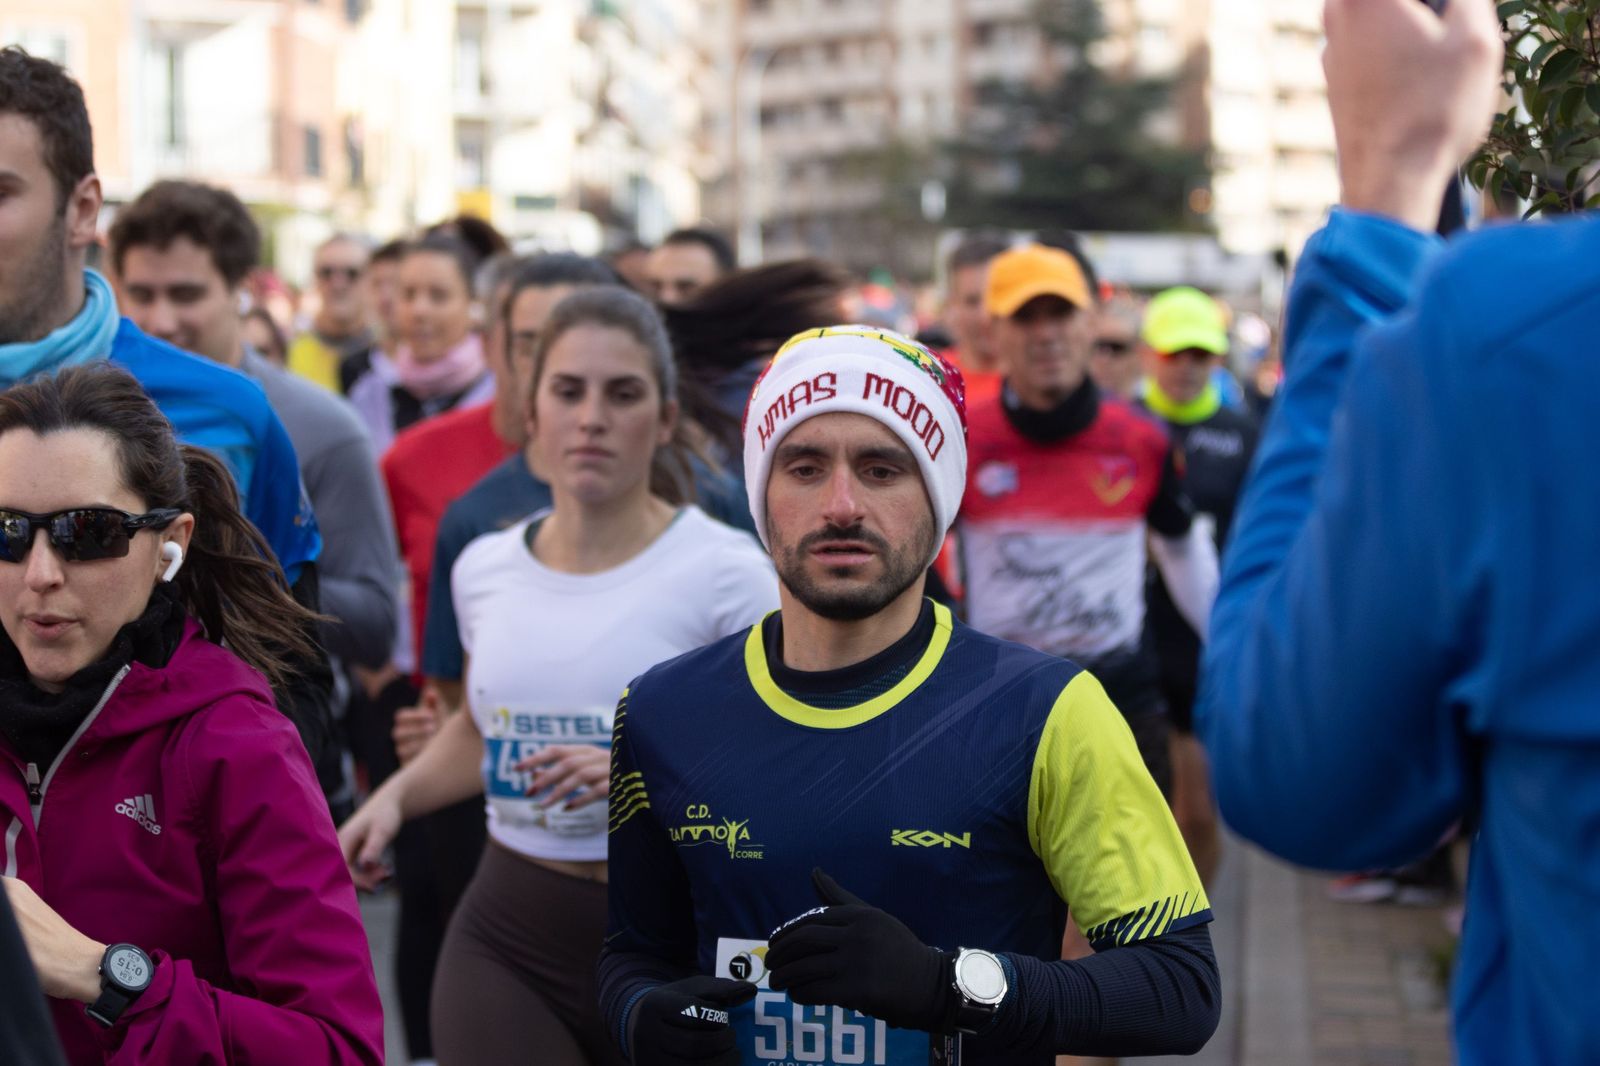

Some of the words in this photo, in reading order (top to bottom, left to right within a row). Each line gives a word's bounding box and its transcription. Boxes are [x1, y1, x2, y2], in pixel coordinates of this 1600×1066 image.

[862, 372, 946, 462] MOOD
[115, 803, 162, 835] adidas
[686, 803, 712, 819] C.D.
[735, 850, 764, 860] CORRE
[117, 957, 143, 976] 0:15
[700, 1006, 730, 1026] TERRE
[754, 991, 887, 1065] 5661
